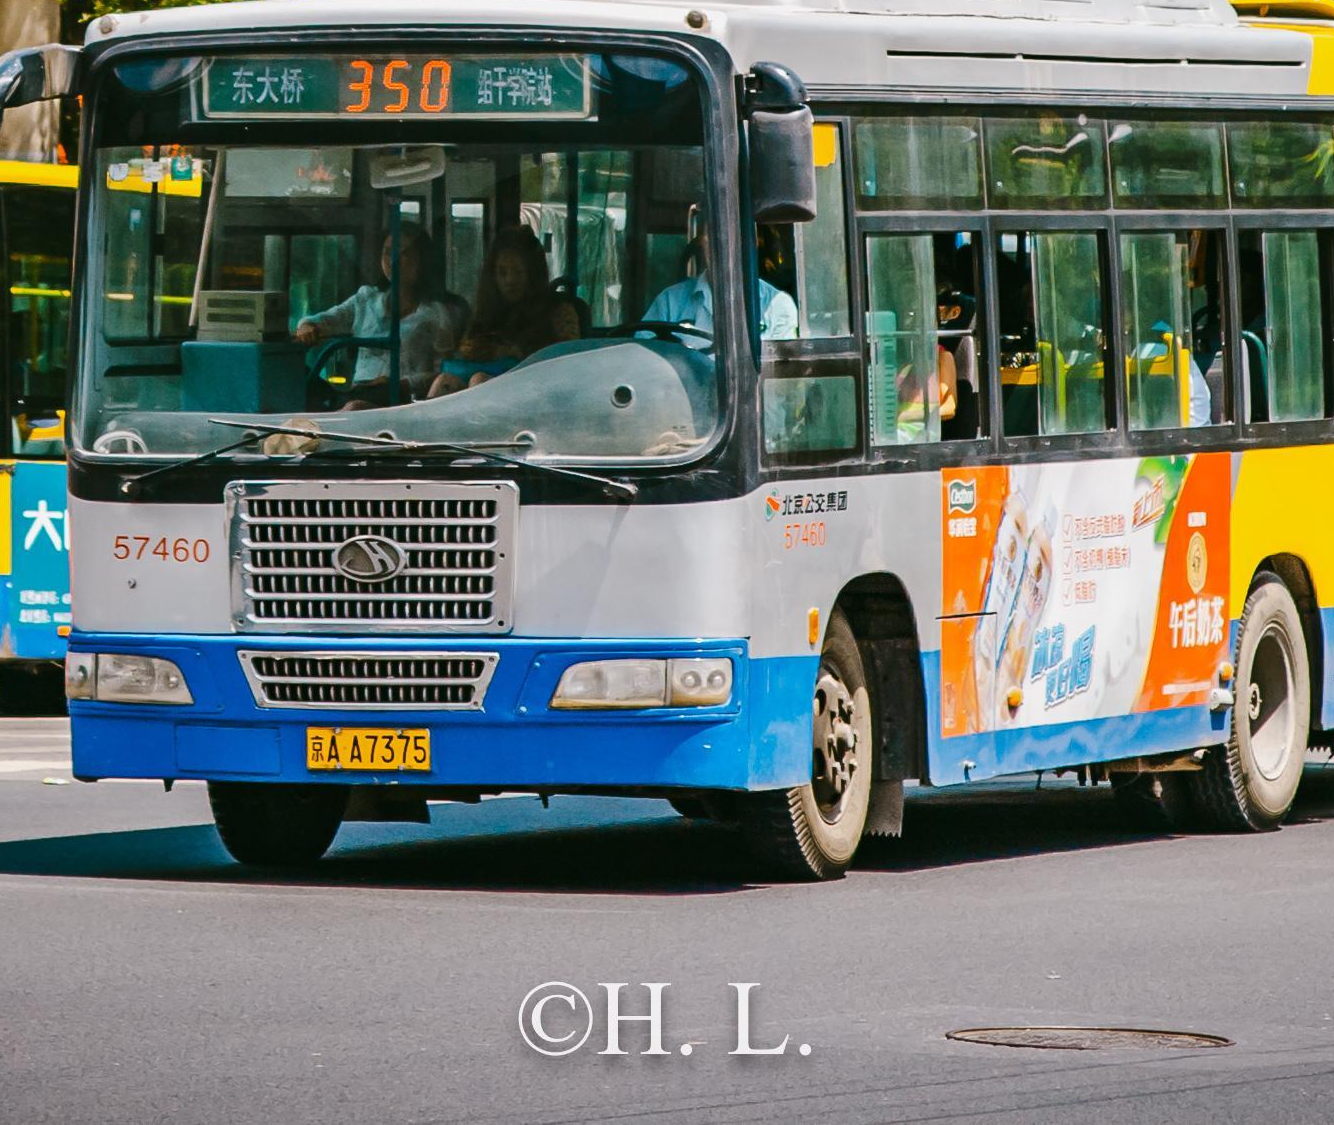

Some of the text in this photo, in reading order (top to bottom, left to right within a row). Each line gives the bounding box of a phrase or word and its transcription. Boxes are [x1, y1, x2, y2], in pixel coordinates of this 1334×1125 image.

[231, 66, 305, 105] 东大桥
[345, 59, 452, 113] 350
[781, 490, 849, 517] 北京公交集团
[22, 499, 69, 552] 大
[783, 522, 827, 549] 57460
[112, 535, 210, 563] 57460
[1169, 595, 1225, 649] 午后奶茶
